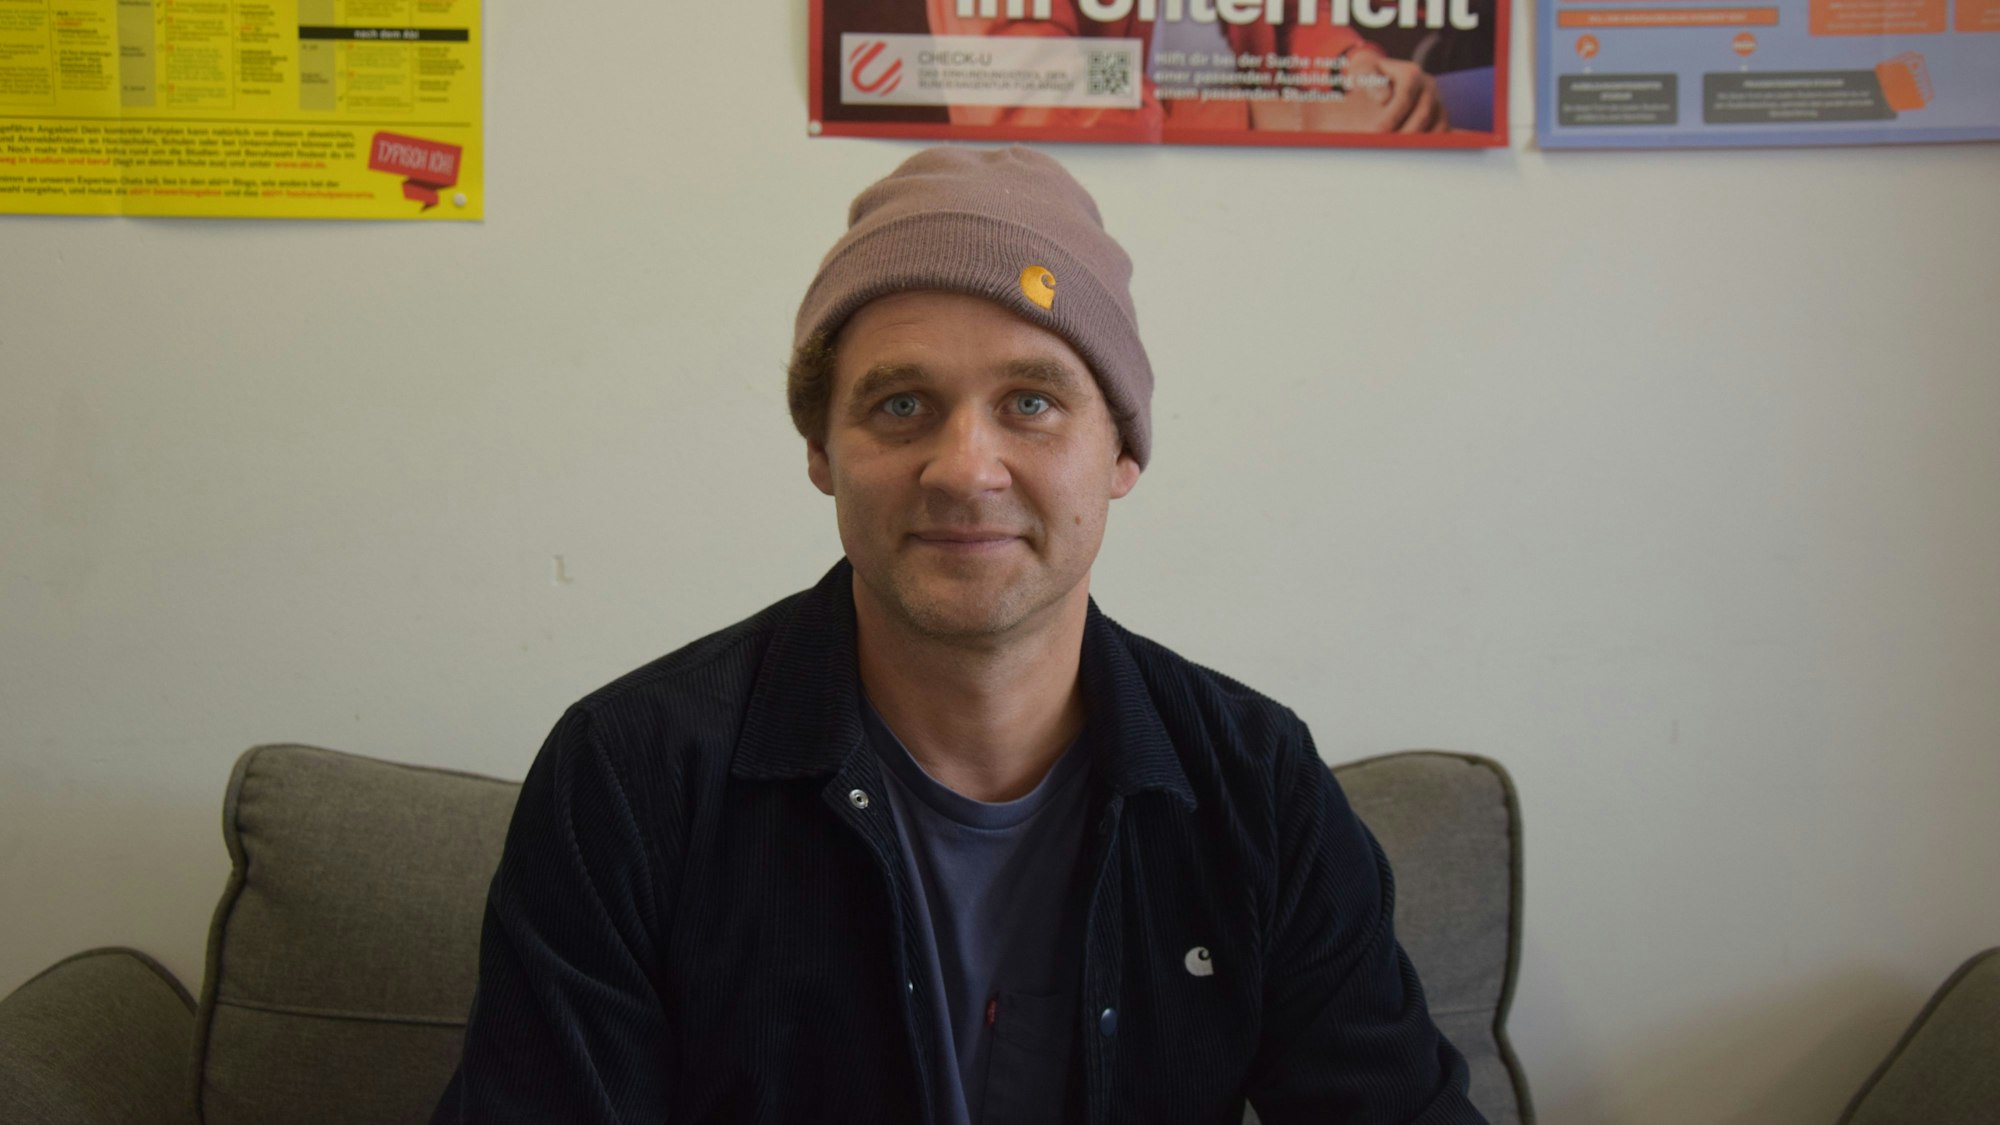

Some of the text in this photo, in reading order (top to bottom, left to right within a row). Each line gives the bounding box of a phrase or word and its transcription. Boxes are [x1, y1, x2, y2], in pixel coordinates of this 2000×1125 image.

[917, 50, 993, 66] CHECK-U
[1238, 53, 1264, 67] der
[1266, 53, 1310, 68] Suche
[1314, 55, 1350, 69] nach
[1153, 70, 1190, 82] einer
[1193, 71, 1272, 86] passenden
[1275, 71, 1353, 88] Ausbildung
[1153, 87, 1345, 102] einem passenden Studium.
